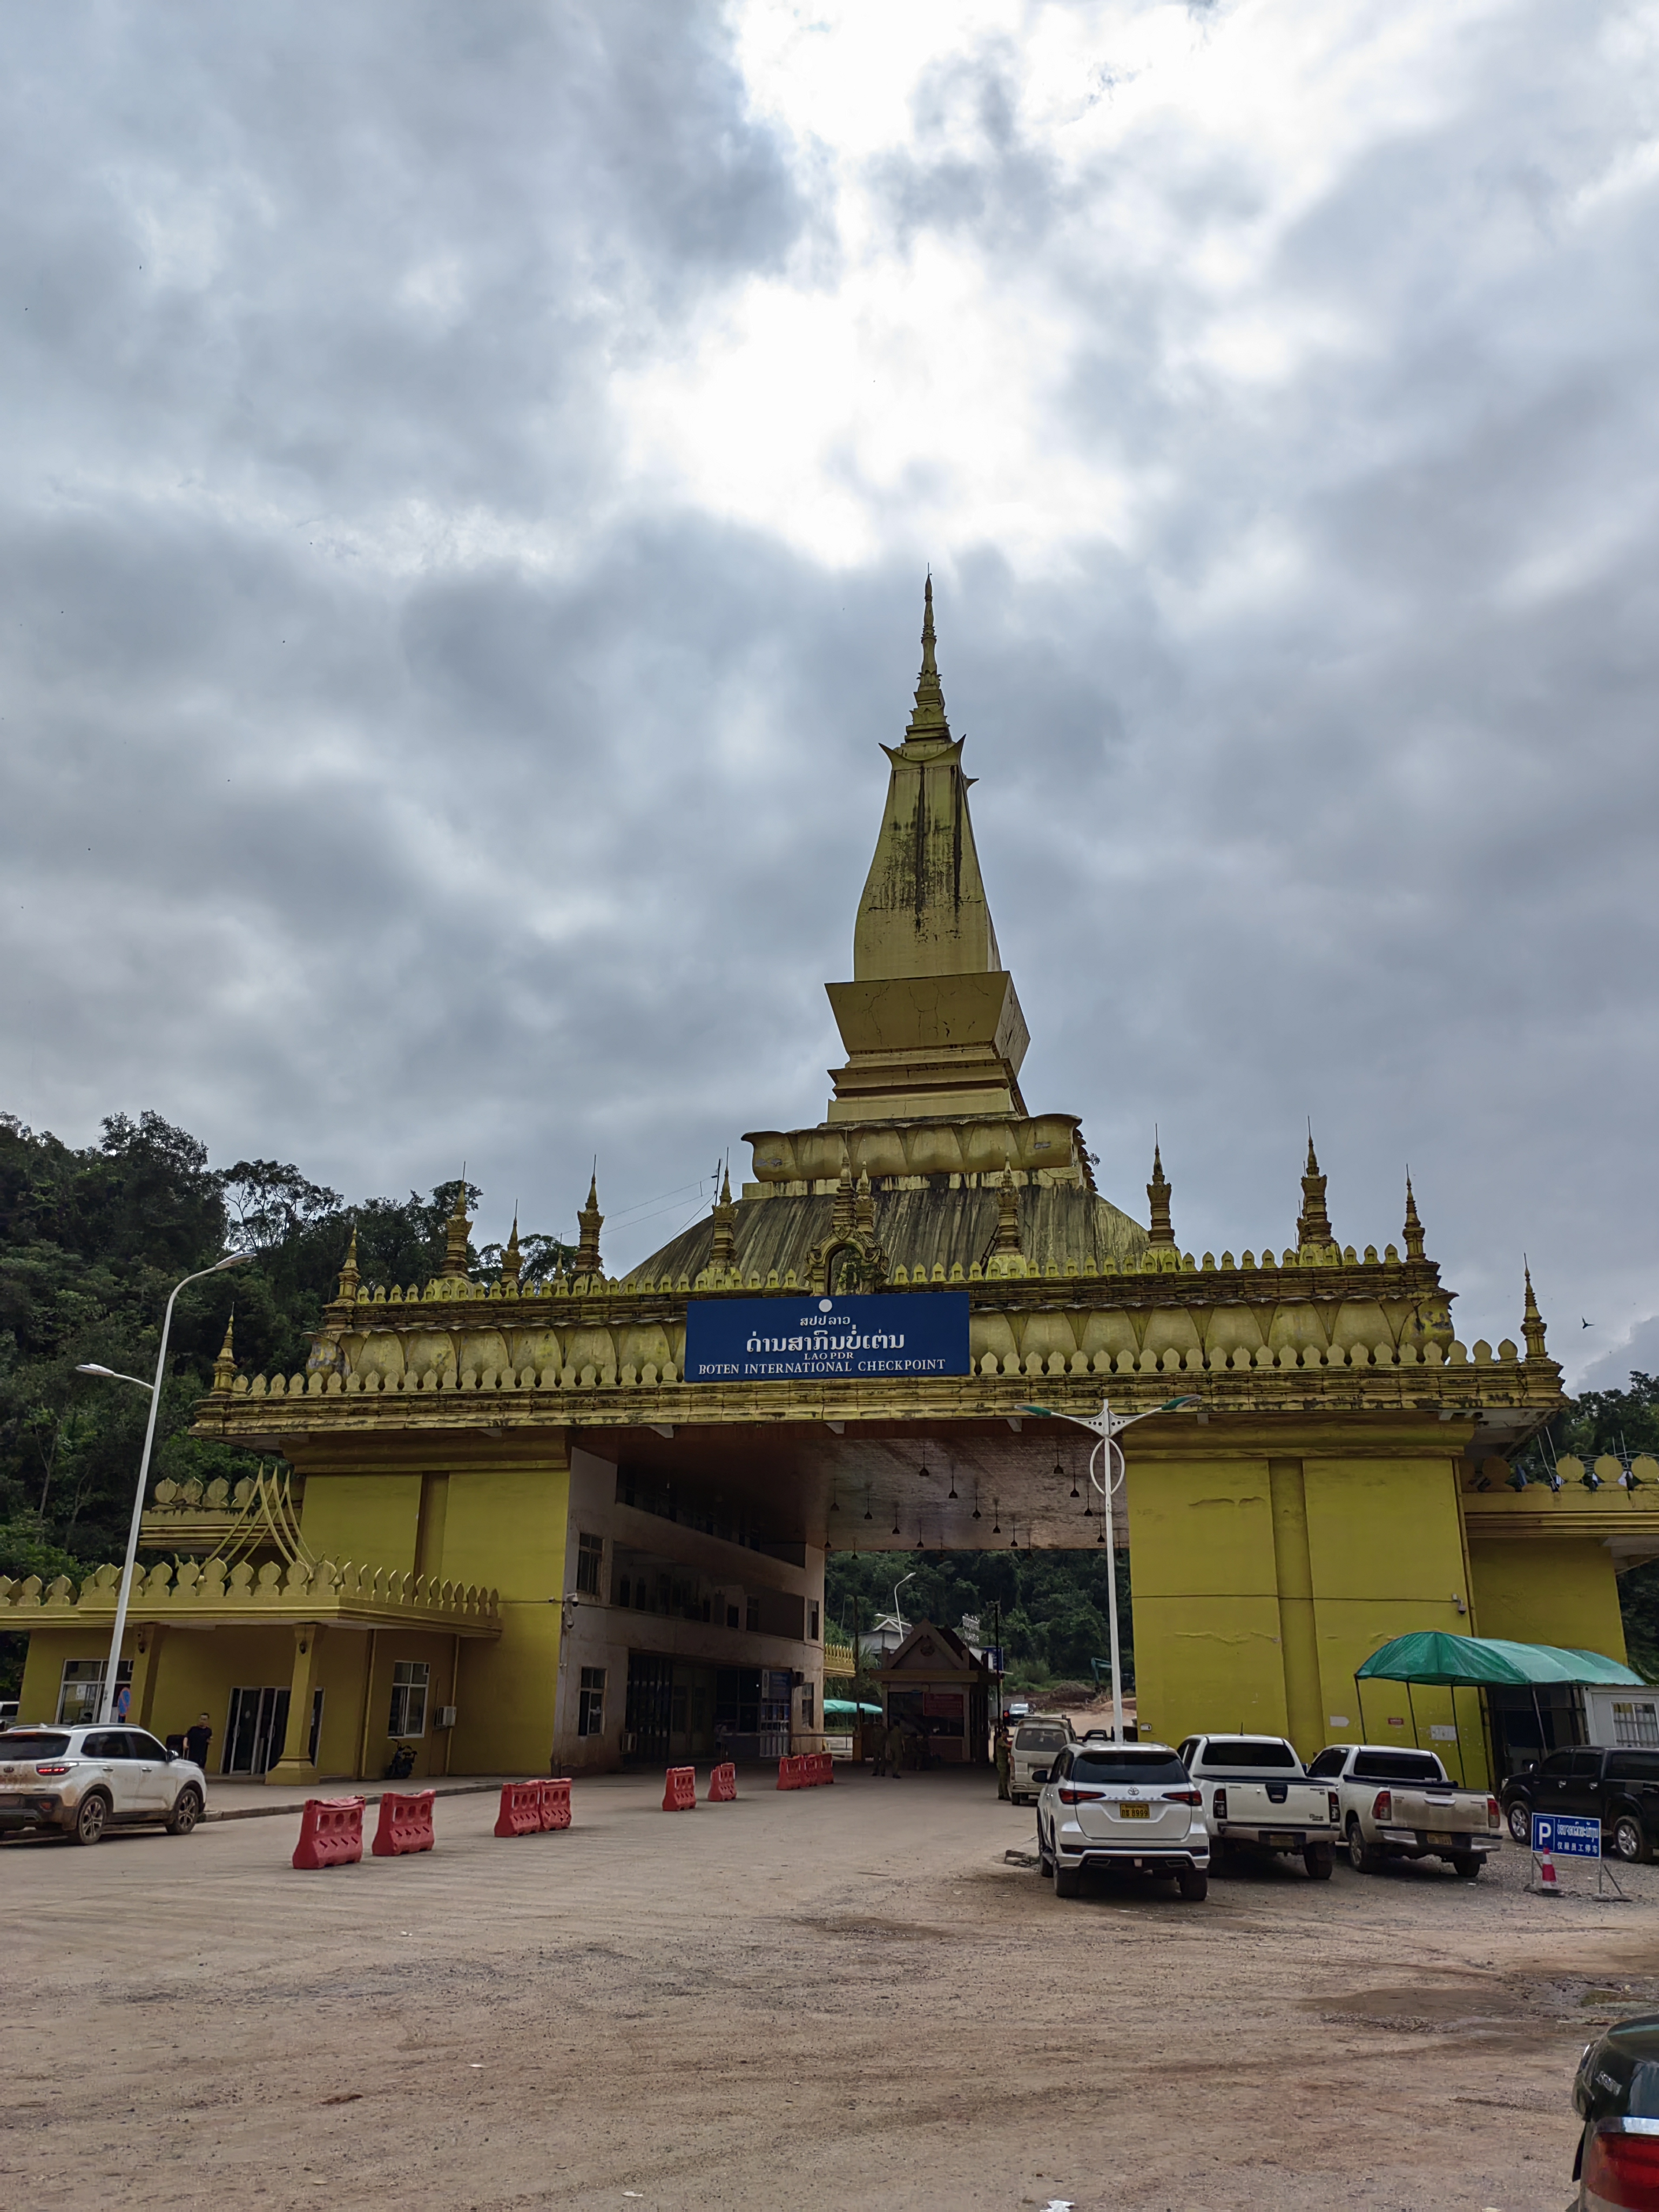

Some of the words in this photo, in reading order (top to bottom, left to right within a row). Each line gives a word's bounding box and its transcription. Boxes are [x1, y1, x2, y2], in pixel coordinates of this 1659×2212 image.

[830, 1352, 854, 1360] PDR
[698, 1364, 740, 1374] BOTEN
[744, 1361, 852, 1374] INTERNATIONAL
[858, 1359, 946, 1372] CHECKPOINT
[1539, 1822, 1552, 1845] P
